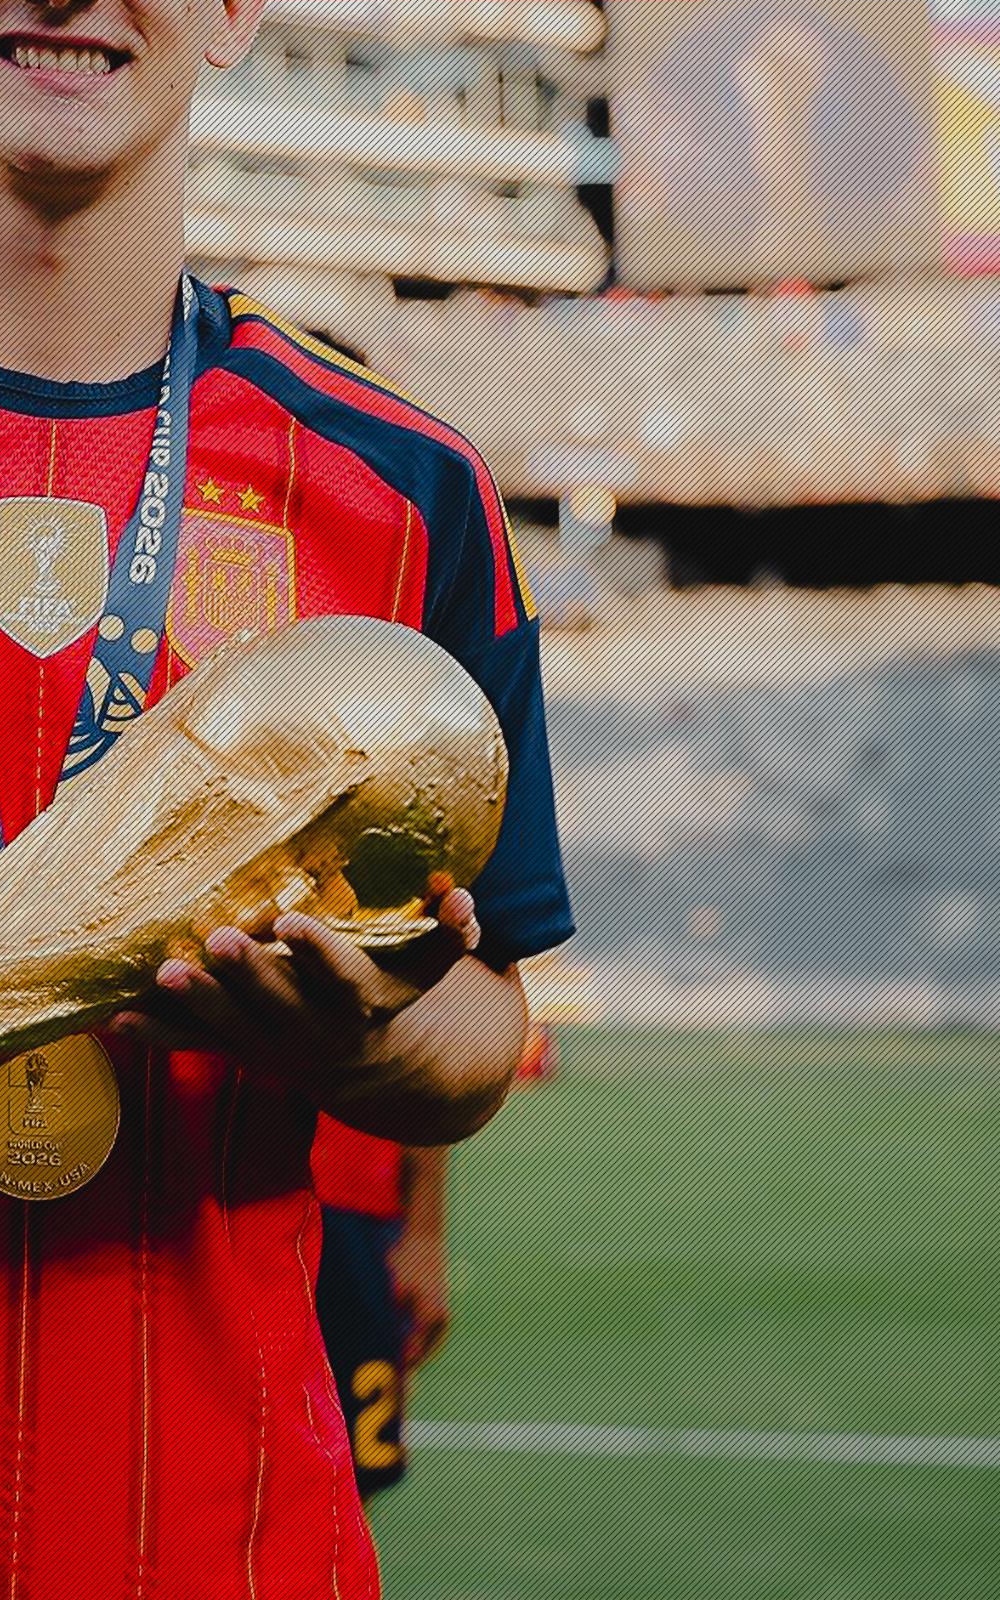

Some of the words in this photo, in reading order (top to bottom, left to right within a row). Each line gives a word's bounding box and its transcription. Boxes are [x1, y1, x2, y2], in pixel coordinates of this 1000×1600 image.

[129, 471, 170, 585] 2026
[19, 596, 73, 618] FIFA
[8, 1139, 42, 1149] WORLD
[8, 1152, 62, 1166] 2026
[352, 1359, 400, 1471] 2
